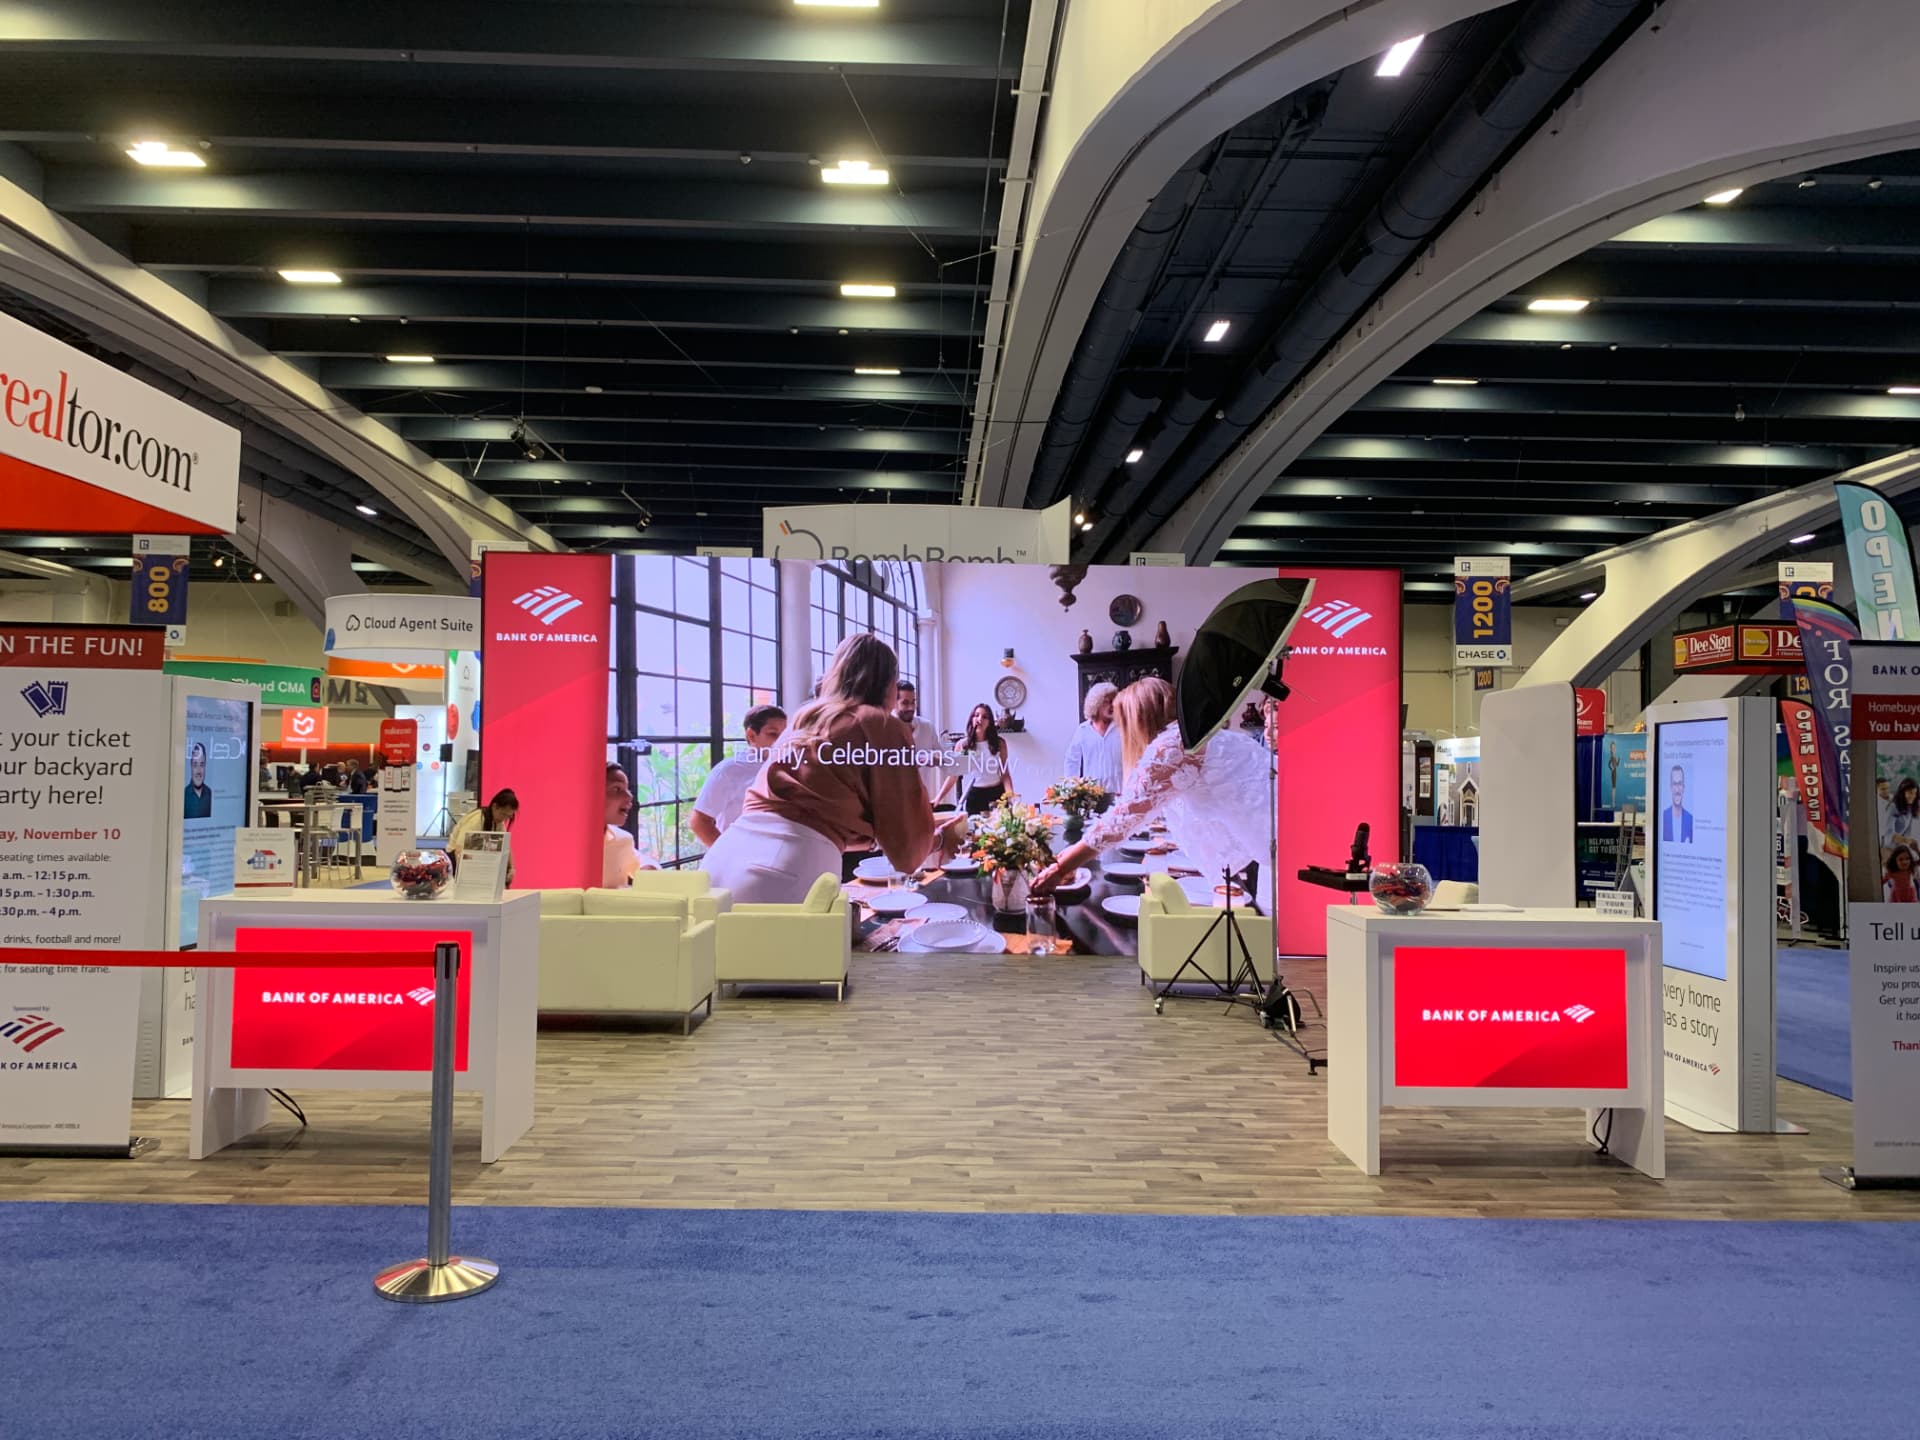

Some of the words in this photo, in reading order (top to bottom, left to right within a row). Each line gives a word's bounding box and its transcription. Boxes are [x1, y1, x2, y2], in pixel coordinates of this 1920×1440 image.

[148, 566, 171, 613] 800
[1472, 581, 1494, 639] 1200
[364, 617, 396, 629] Cloud
[399, 617, 437, 632] Agent
[440, 618, 474, 632] Suite
[496, 633, 527, 642] BANK
[529, 633, 545, 642] OF
[546, 633, 598, 642] AMERICA
[1709, 633, 1731, 652] Sign
[24, 636, 75, 655] THE
[84, 637, 144, 656] FUN!
[1320, 646, 1335, 655] OF
[1336, 647, 1387, 656] AMERICA
[1457, 650, 1495, 659] CHASE
[1872, 665, 1907, 675] BANK
[278, 680, 305, 694] CMA
[1869, 720, 1891, 733] You
[10, 731, 60, 751] your
[68, 728, 131, 748] ticket
[816, 742, 960, 766] Celebrations.
[34, 756, 133, 780] backyard
[49, 785, 103, 805] here!
[23, 828, 98, 840] November
[103, 828, 121, 840] 10
[0, 853, 34, 863] seating
[36, 853, 65, 862] times
[2, 872, 25, 880] a.m.
[35, 871, 66, 880] 12:15
[67, 872, 91, 882] p.m.
[13, 890, 36, 899] p.m.
[45, 888, 71, 898] 1:30
[71, 890, 95, 899] p.m.
[17, 909, 40, 918] p.m.
[49, 907, 56, 916] 4
[58, 909, 82, 918] p.m.
[1868, 921, 1904, 940] Tell
[3, 934, 33, 944] drinks,
[35, 934, 72, 944] football
[74, 934, 92, 944] and
[93, 935, 121, 944] more!
[4, 964, 17, 973] for
[19, 965, 54, 975] seating
[56, 965, 78, 973] time
[1873, 963, 1907, 974] Inspire
[1881, 981, 1899, 991] you
[261, 991, 306, 1004] BANK
[309, 992, 330, 1004] OF
[332, 992, 404, 1005] AMERICA
[1663, 984, 1686, 1007] very
[1688, 984, 1721, 1013] home
[1879, 995, 1896, 1005] Get
[1422, 1009, 1464, 1022] BANK
[1468, 1009, 1488, 1022] OF
[1490, 1010, 1561, 1023] AMERICA
[1896, 1011, 1904, 1021] it
[1680, 1016, 1687, 1031] a
[1690, 1018, 1719, 1047] story
[10, 1062, 24, 1070] OF
[26, 1062, 78, 1070] AMERICA
[1682, 1056, 1708, 1072] AMERICA
